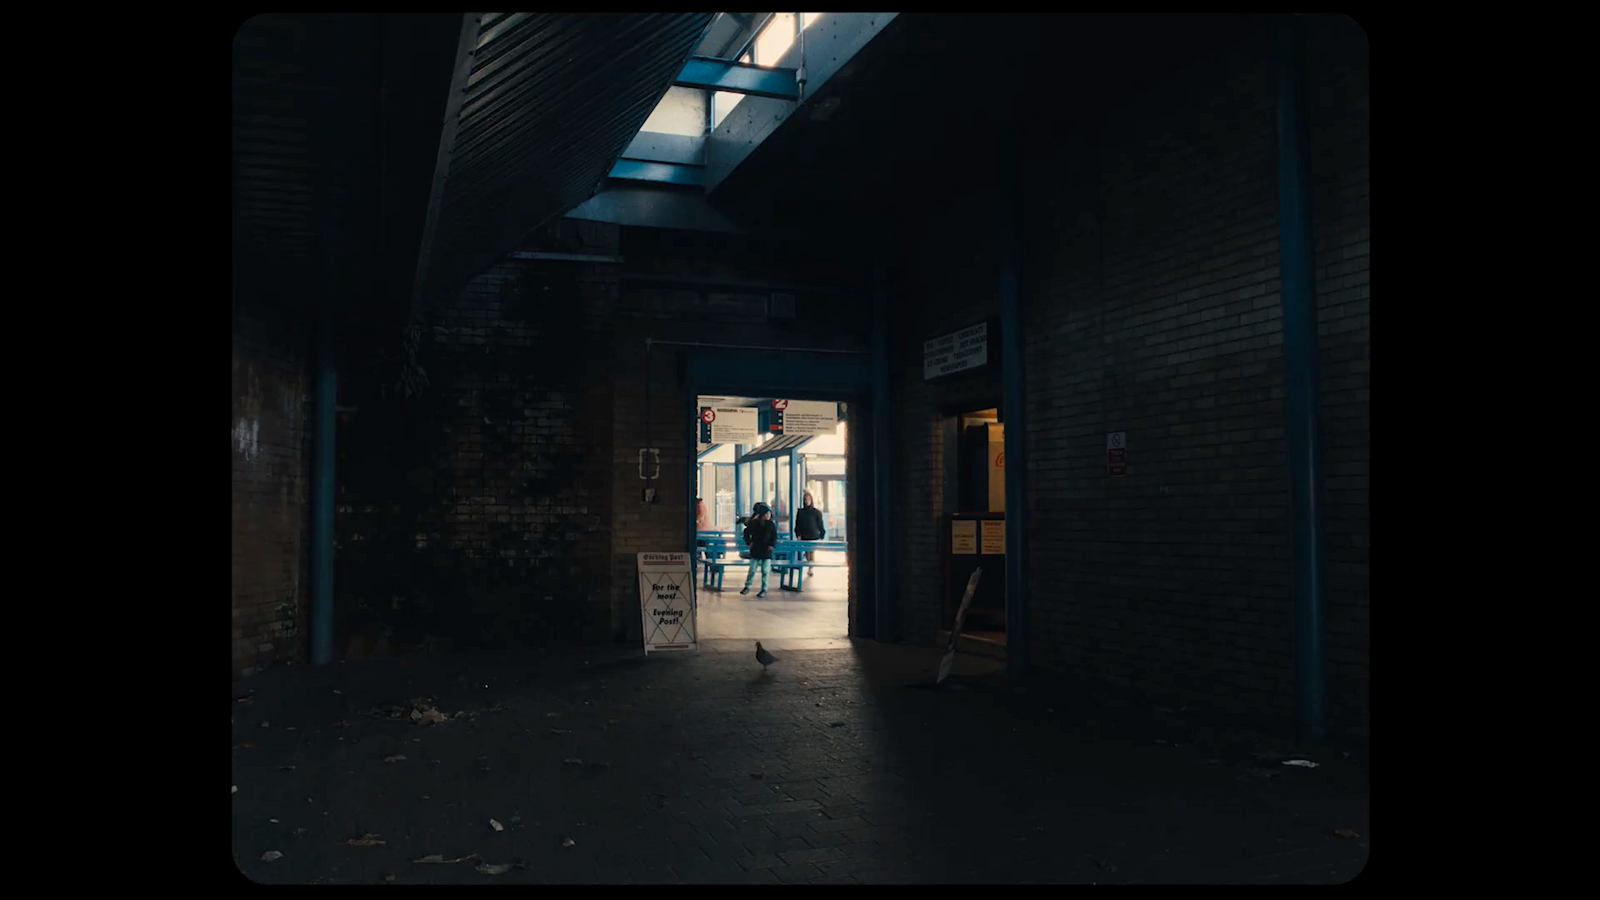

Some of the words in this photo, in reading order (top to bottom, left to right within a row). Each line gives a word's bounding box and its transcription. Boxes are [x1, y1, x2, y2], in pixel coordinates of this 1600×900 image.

[775, 399, 786, 408] 2
[704, 410, 714, 422] 3
[652, 583, 664, 591] For
[667, 583, 680, 591] the
[653, 608, 683, 617] Evening
[659, 617, 679, 625] Post!
